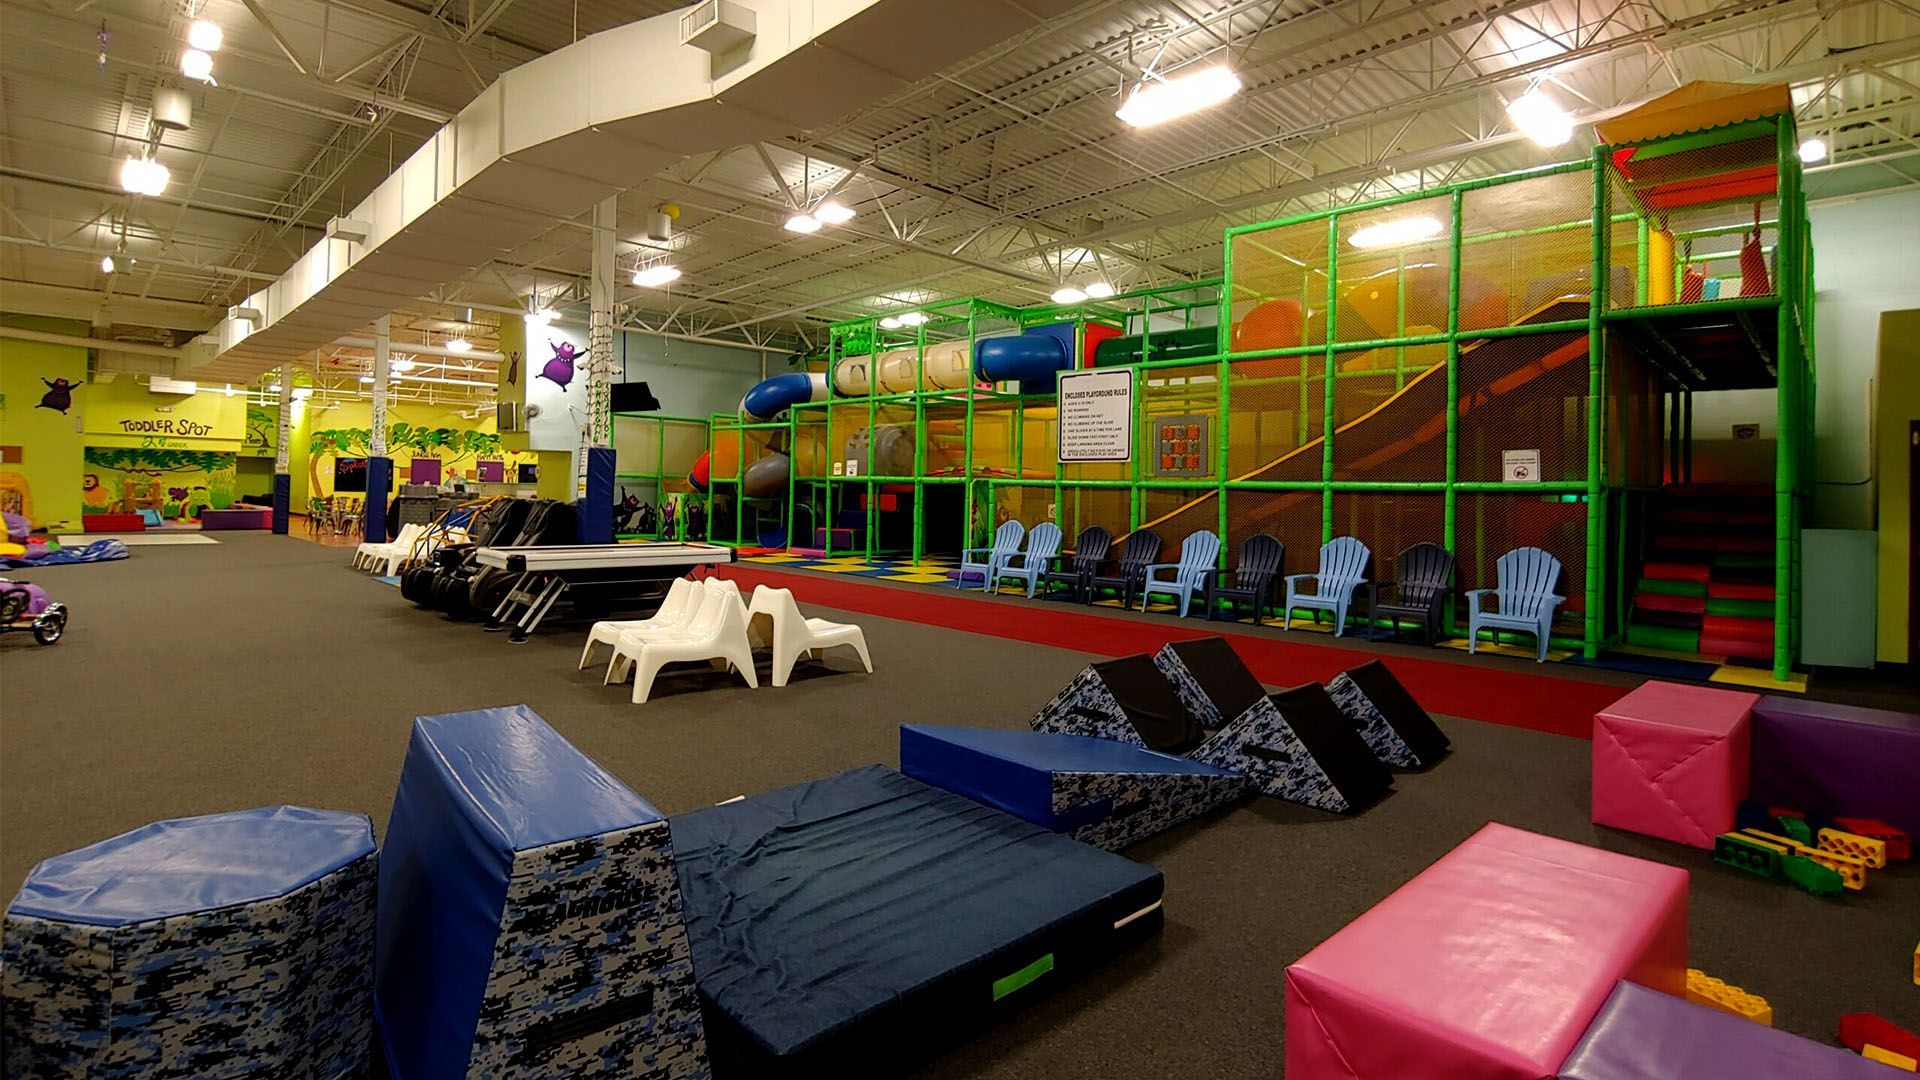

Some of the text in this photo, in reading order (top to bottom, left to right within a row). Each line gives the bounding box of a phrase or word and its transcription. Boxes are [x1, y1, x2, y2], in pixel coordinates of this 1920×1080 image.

[1086, 390, 1113, 398] PLAYGROUND
[120, 418, 213, 436] TODDLER SPOT
